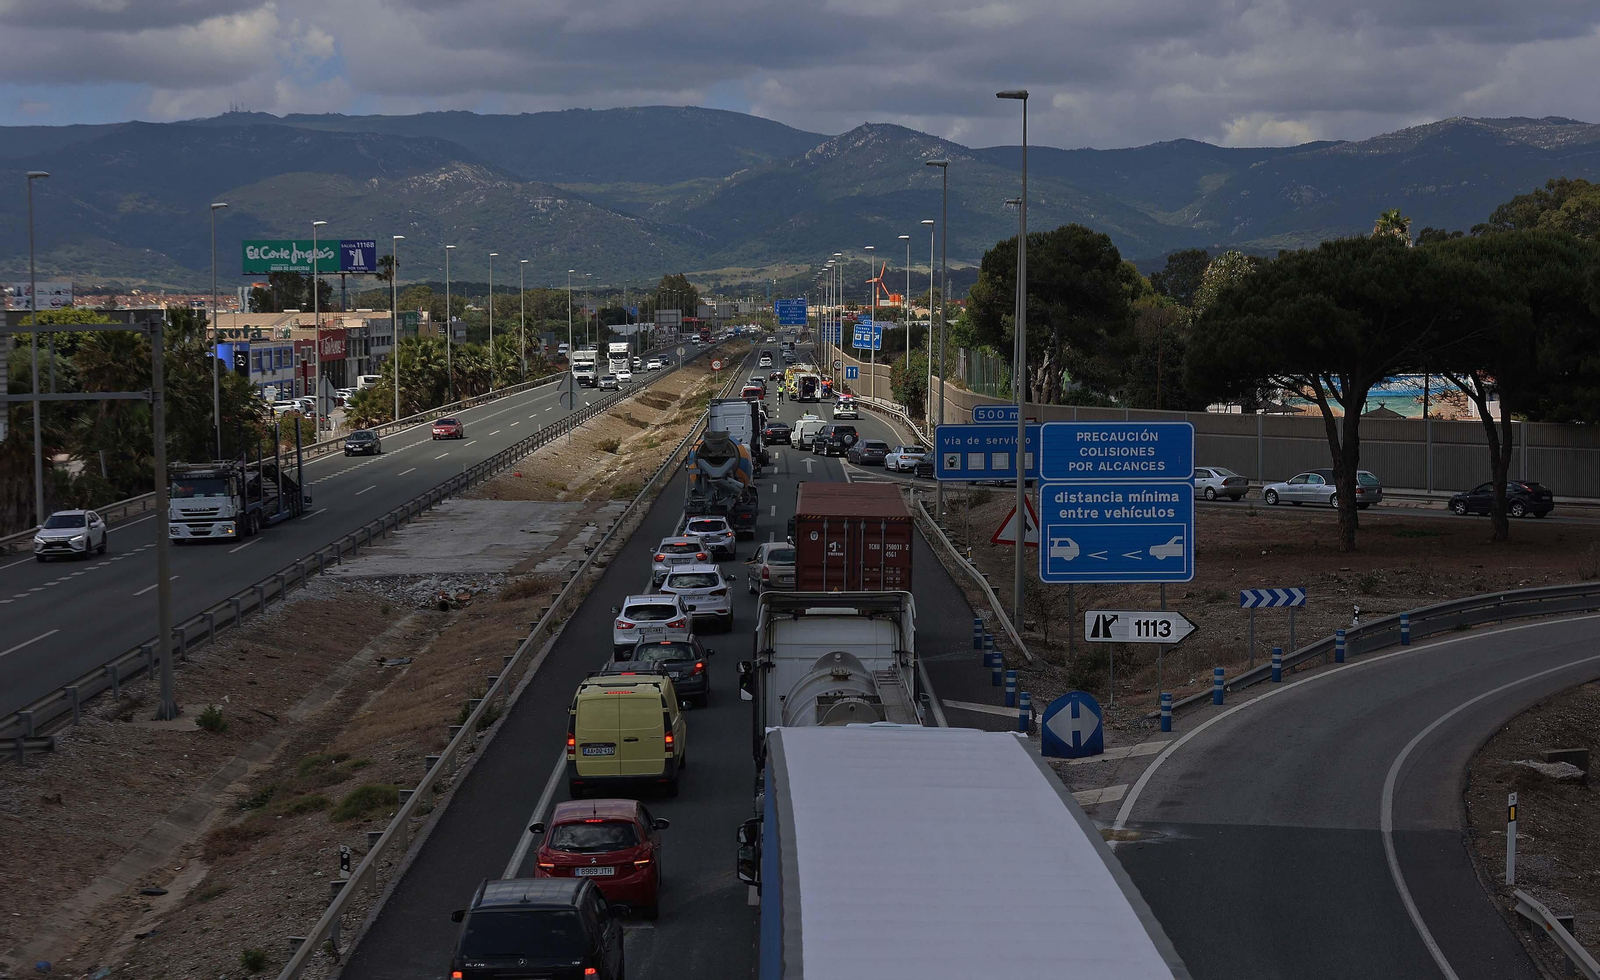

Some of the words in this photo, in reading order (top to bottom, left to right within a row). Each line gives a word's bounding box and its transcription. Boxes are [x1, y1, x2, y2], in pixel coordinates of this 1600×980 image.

[246, 246, 260, 260] El
[260, 246, 290, 260] Corte
[291, 242, 335, 264] Inglés
[978, 410, 1004, 419] 500
[944, 436, 961, 445] vía
[967, 436, 980, 444] de
[986, 436, 1030, 445] servico
[1076, 429, 1159, 442] PRECAUCIÓN
[1080, 446, 1155, 456] COLISIONES
[1068, 462, 1093, 471] POR
[1098, 462, 1166, 471] ALCANCES
[1055, 491, 1123, 503] distancia
[1128, 489, 1180, 502] mínima
[1059, 506, 1098, 518] entre
[1104, 506, 1175, 518] vehículos
[1134, 619, 1172, 638] 1113
